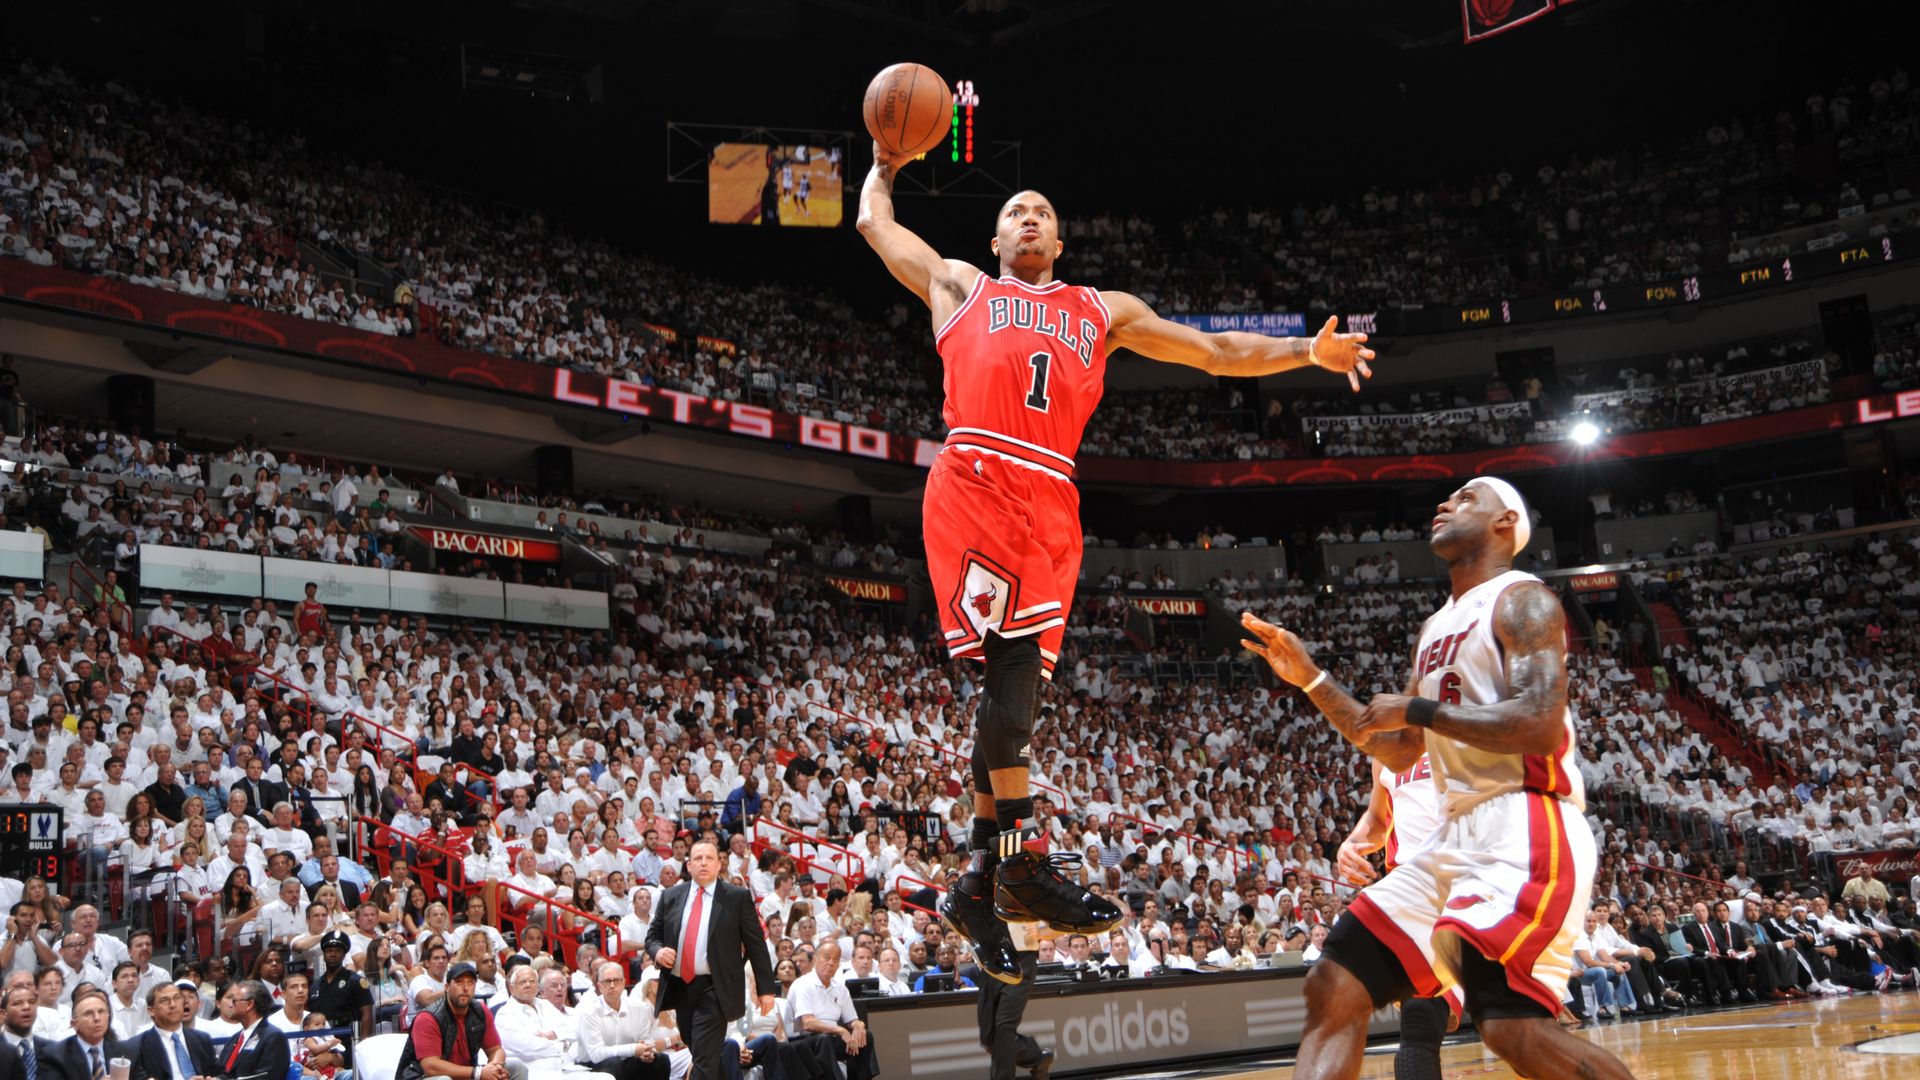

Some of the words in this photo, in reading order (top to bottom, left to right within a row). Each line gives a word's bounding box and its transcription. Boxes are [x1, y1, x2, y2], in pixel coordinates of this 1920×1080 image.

[956, 80, 974, 95] 13
[1840, 248, 1870, 264] FTA
[1740, 267, 1771, 285] FTM
[1784, 270, 1793, 281] 2
[1646, 286, 1677, 301] FG%
[1554, 298, 1583, 312] FGA
[1210, 315, 1240, 330] (954)
[1243, 314, 1303, 328] AC-REPAIR
[1461, 308, 1490, 323] FGM
[988, 295, 1098, 369] BULLS
[1025, 351, 1052, 414] 1
[1770, 370, 1782, 380] to
[554, 367, 774, 439] LET'S
[801, 415, 890, 460] GO
[1307, 415, 1363, 431] Report
[432, 530, 525, 559] BACARDI
[826, 577, 890, 600] ACARDI
[1417, 618, 1480, 681] HEAT
[1439, 671, 1462, 706] 6
[6, 812, 27, 833] 17
[28, 841, 53, 850] BULLS
[37, 855, 57, 877] 13
[1062, 999, 1189, 1057] adidas
